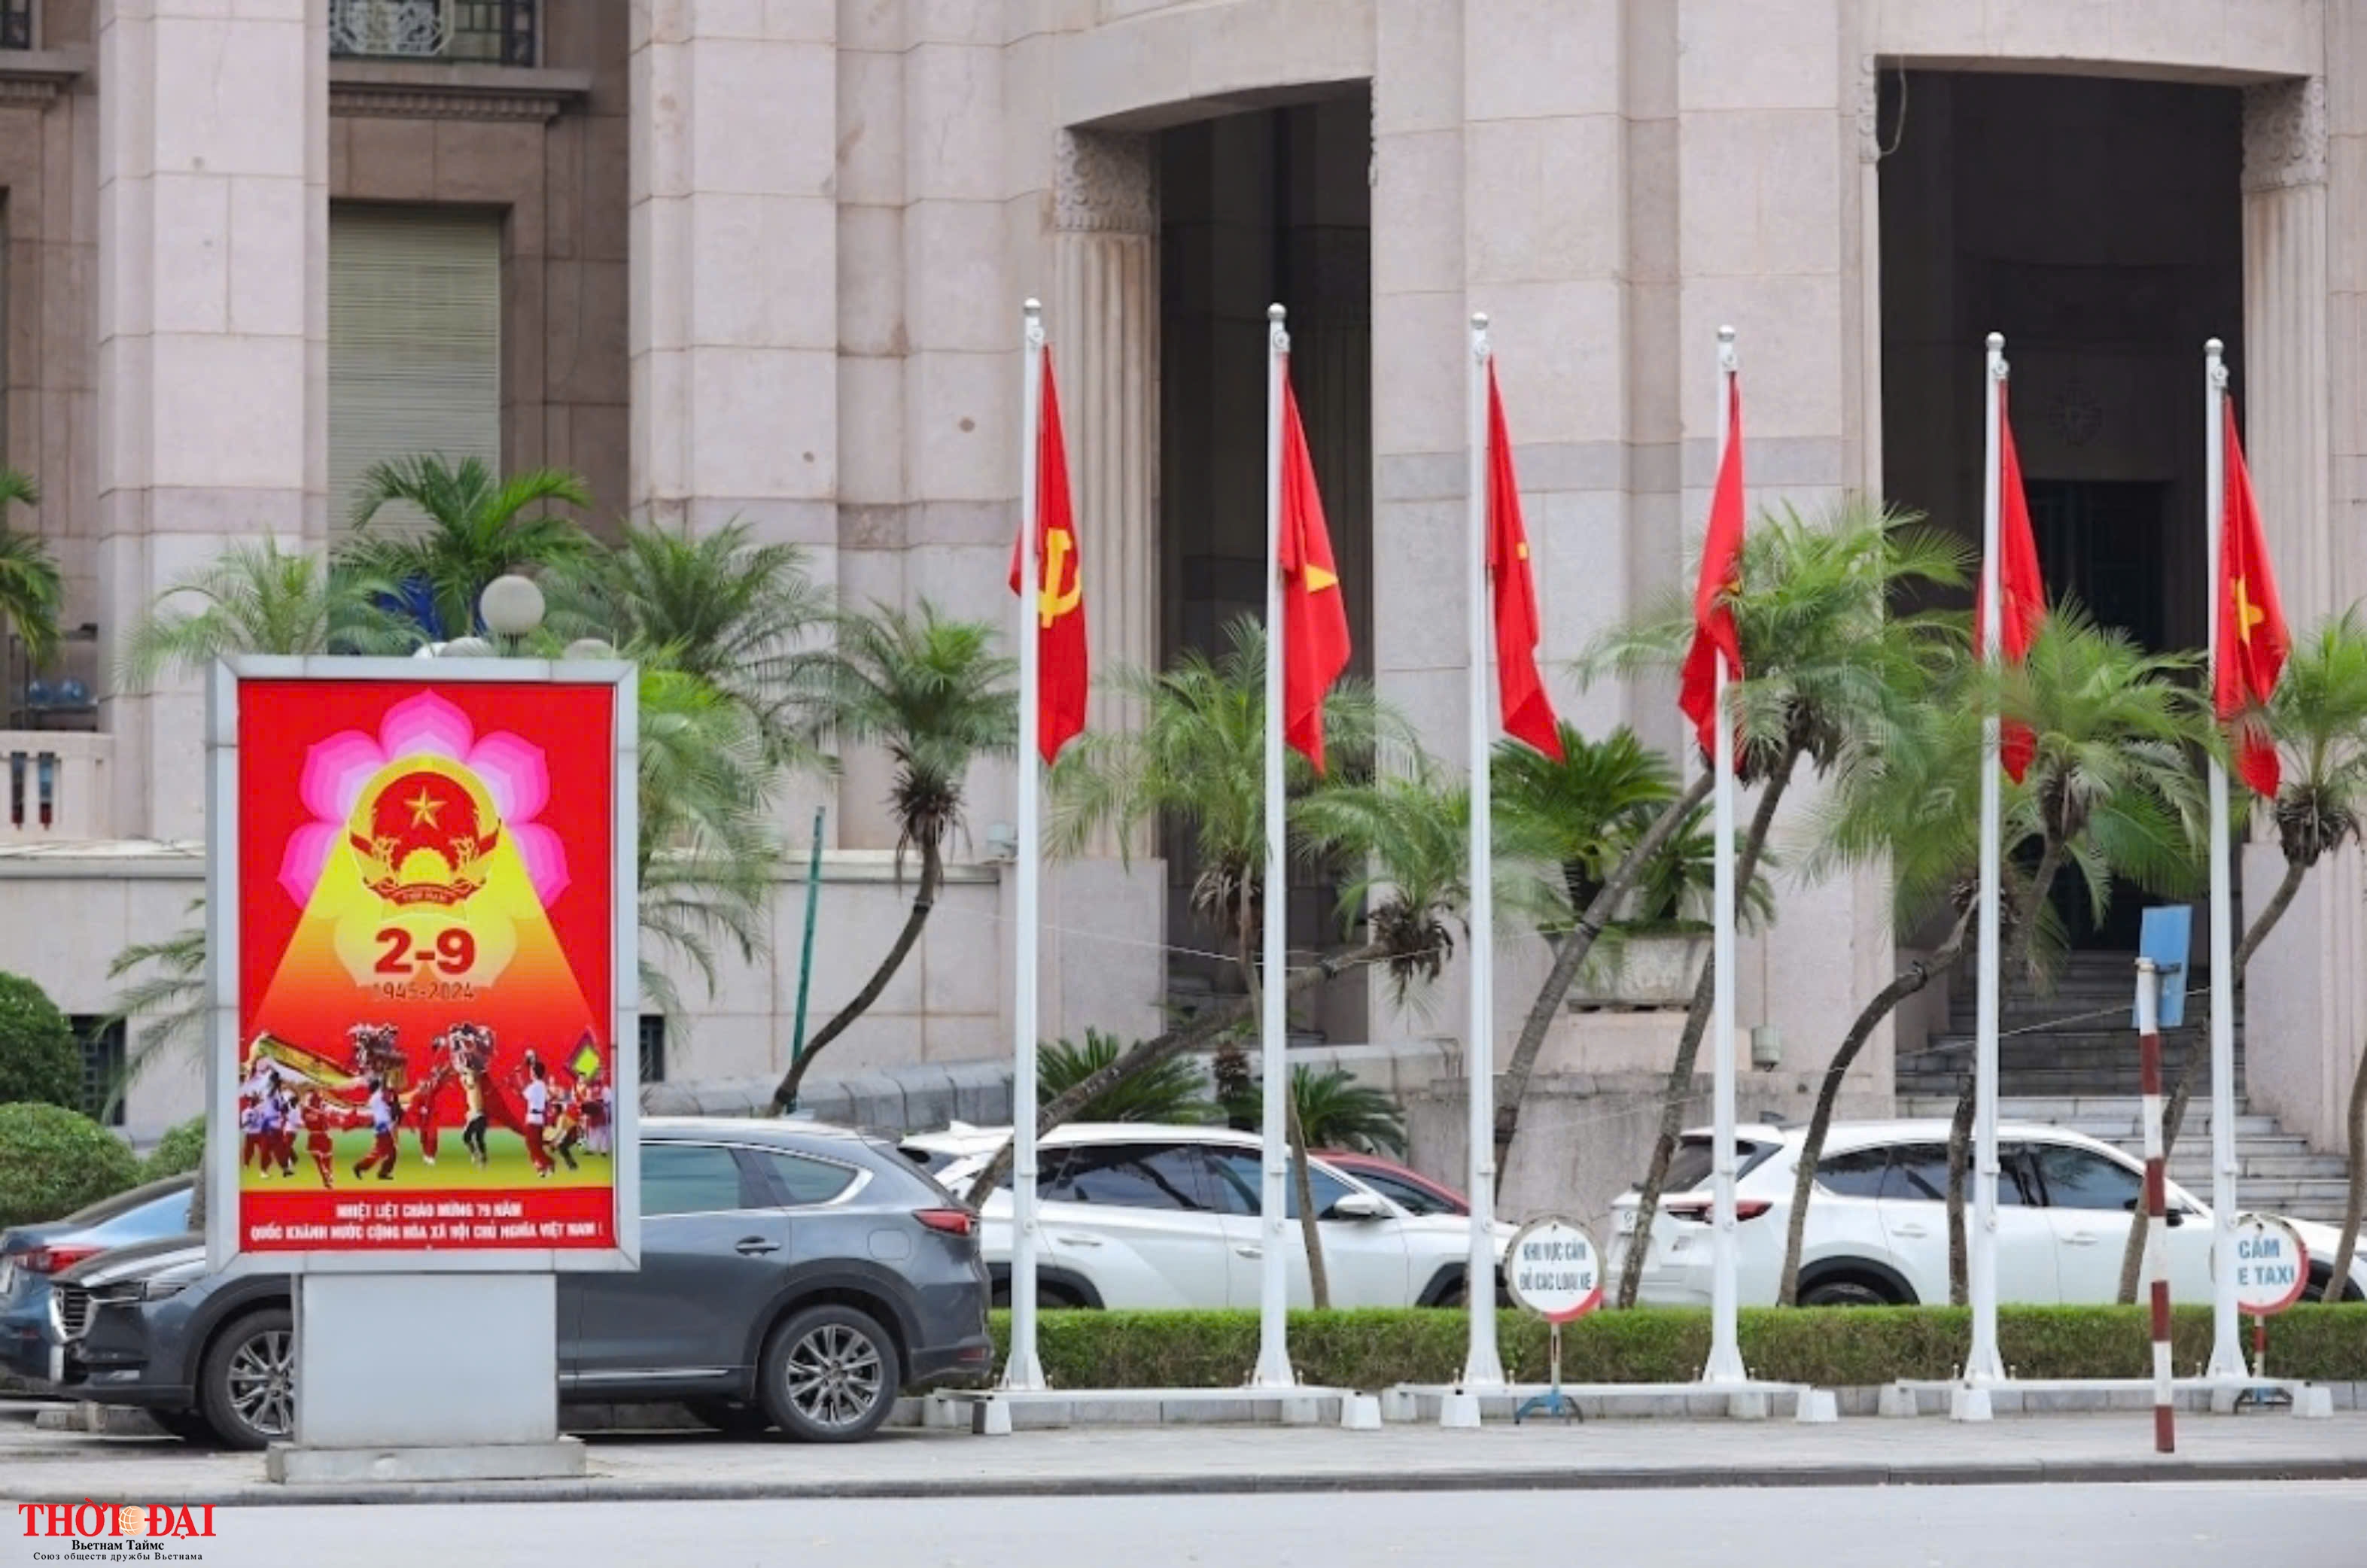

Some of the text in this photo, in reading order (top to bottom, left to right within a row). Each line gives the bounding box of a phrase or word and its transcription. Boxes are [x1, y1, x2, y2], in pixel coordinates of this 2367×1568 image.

[375, 928, 475, 974] 2-9
[374, 981, 474, 1000] 1945-2024
[2255, 1266, 2295, 1285] TAXI
